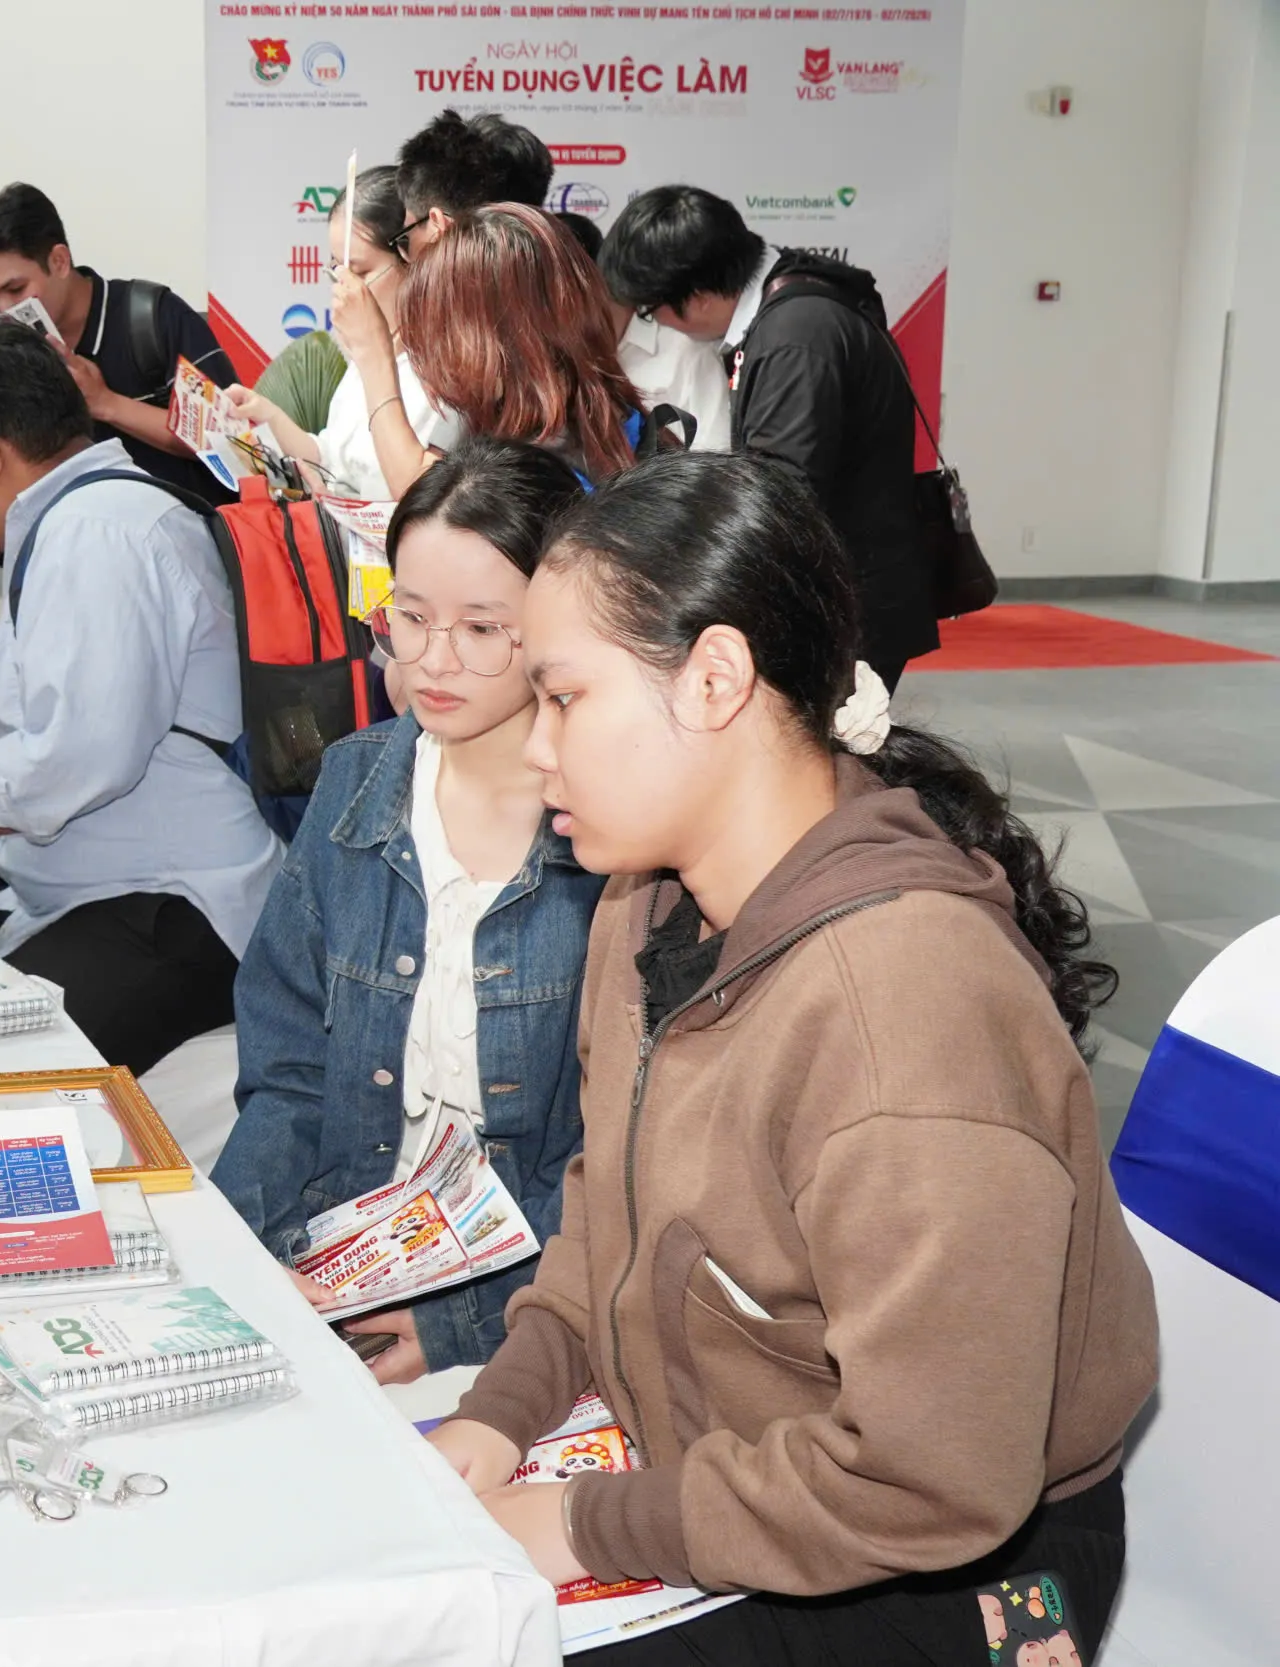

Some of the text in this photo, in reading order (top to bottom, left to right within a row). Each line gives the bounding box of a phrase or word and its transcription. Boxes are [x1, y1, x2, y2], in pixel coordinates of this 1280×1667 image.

[220, 3, 248, 18] CHÀO
[329, 6, 342, 18] 50
[372, 4, 400, 19] NGÀY
[402, 4, 435, 19] THÀNH
[510, 7, 528, 19] GIA
[659, 8, 689, 20] MANG
[691, 5, 710, 20] TÊN
[793, 8, 819, 20] MINH
[487, 41, 578, 61] NGÀY HỘI
[415, 56, 747, 101] TUYỂN DỤNG VIỆC LÀM
[795, 86, 836, 101] VLSC
[745, 195, 836, 209] Vietcombank
